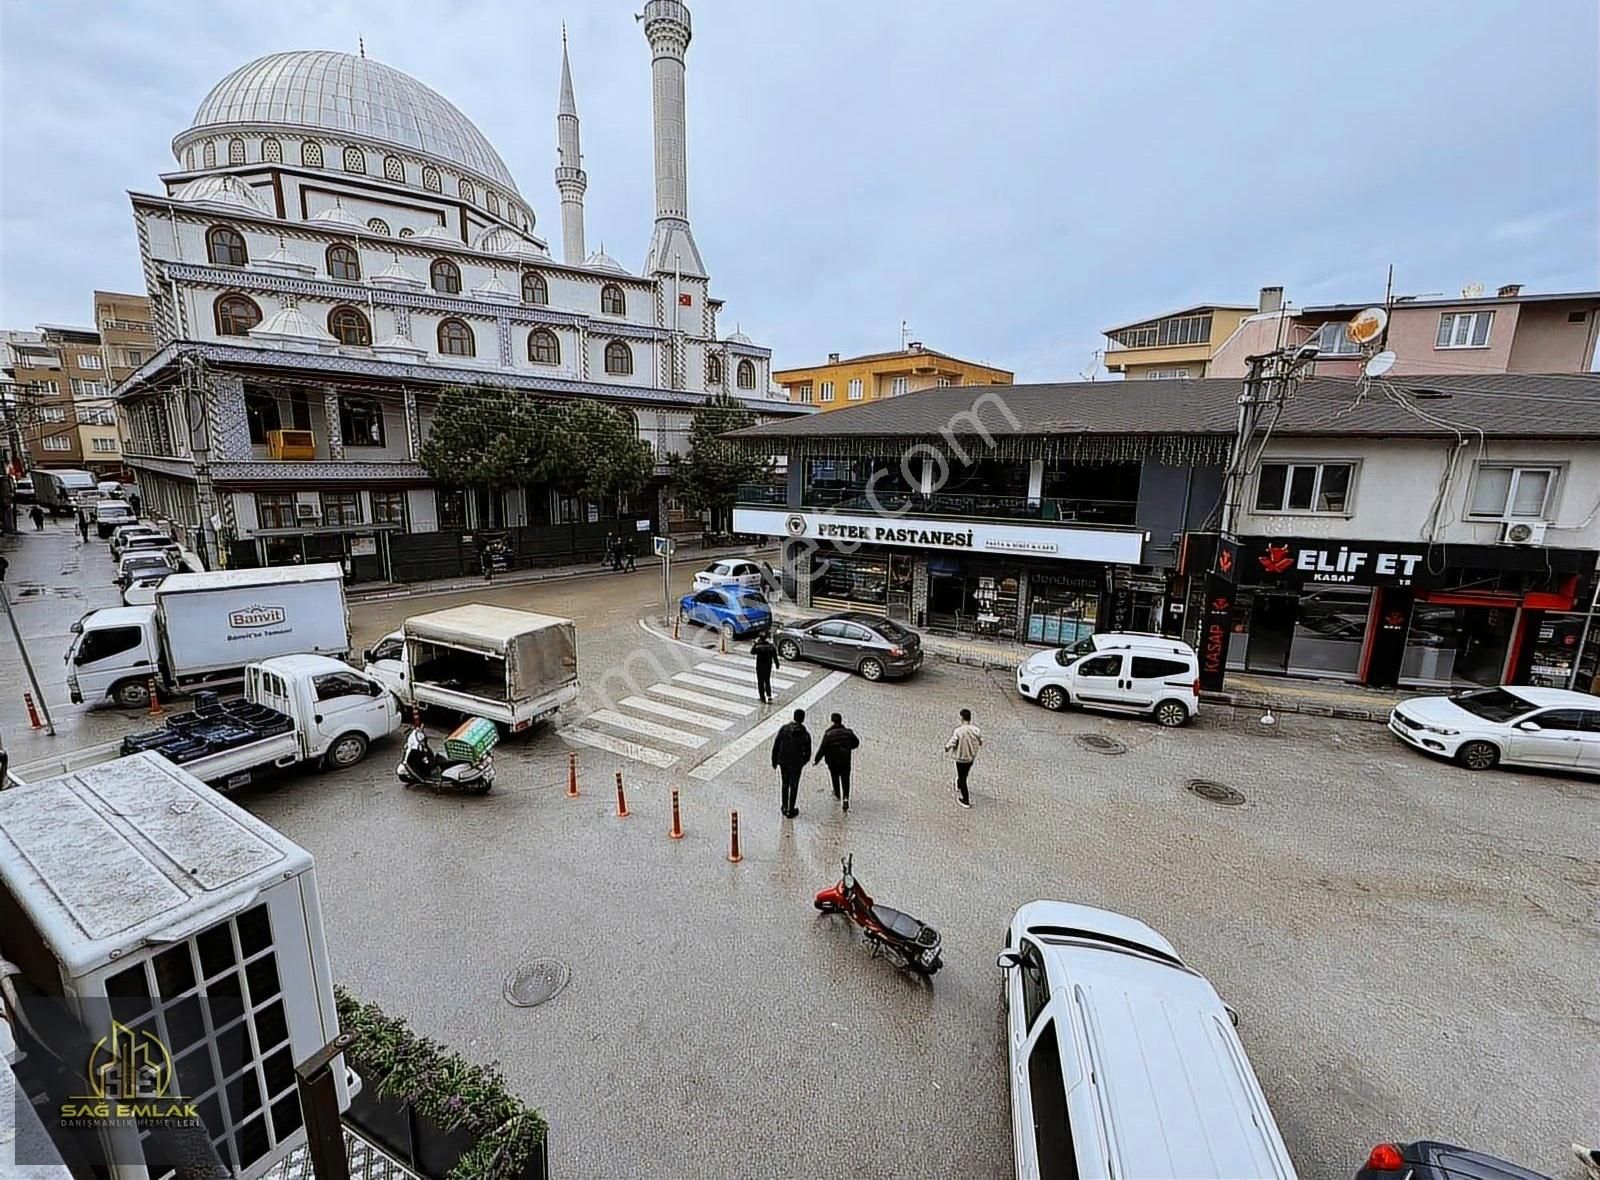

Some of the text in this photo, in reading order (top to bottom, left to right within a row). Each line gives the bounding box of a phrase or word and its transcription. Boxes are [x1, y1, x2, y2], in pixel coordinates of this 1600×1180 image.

[818, 523, 974, 547] PETEK PASTANESİ
[1297, 546, 1423, 576] ELİF ET
[1314, 574, 1354, 583] KASAP
[233, 610, 282, 625] Banvit
[1205, 624, 1223, 673] KASAP
